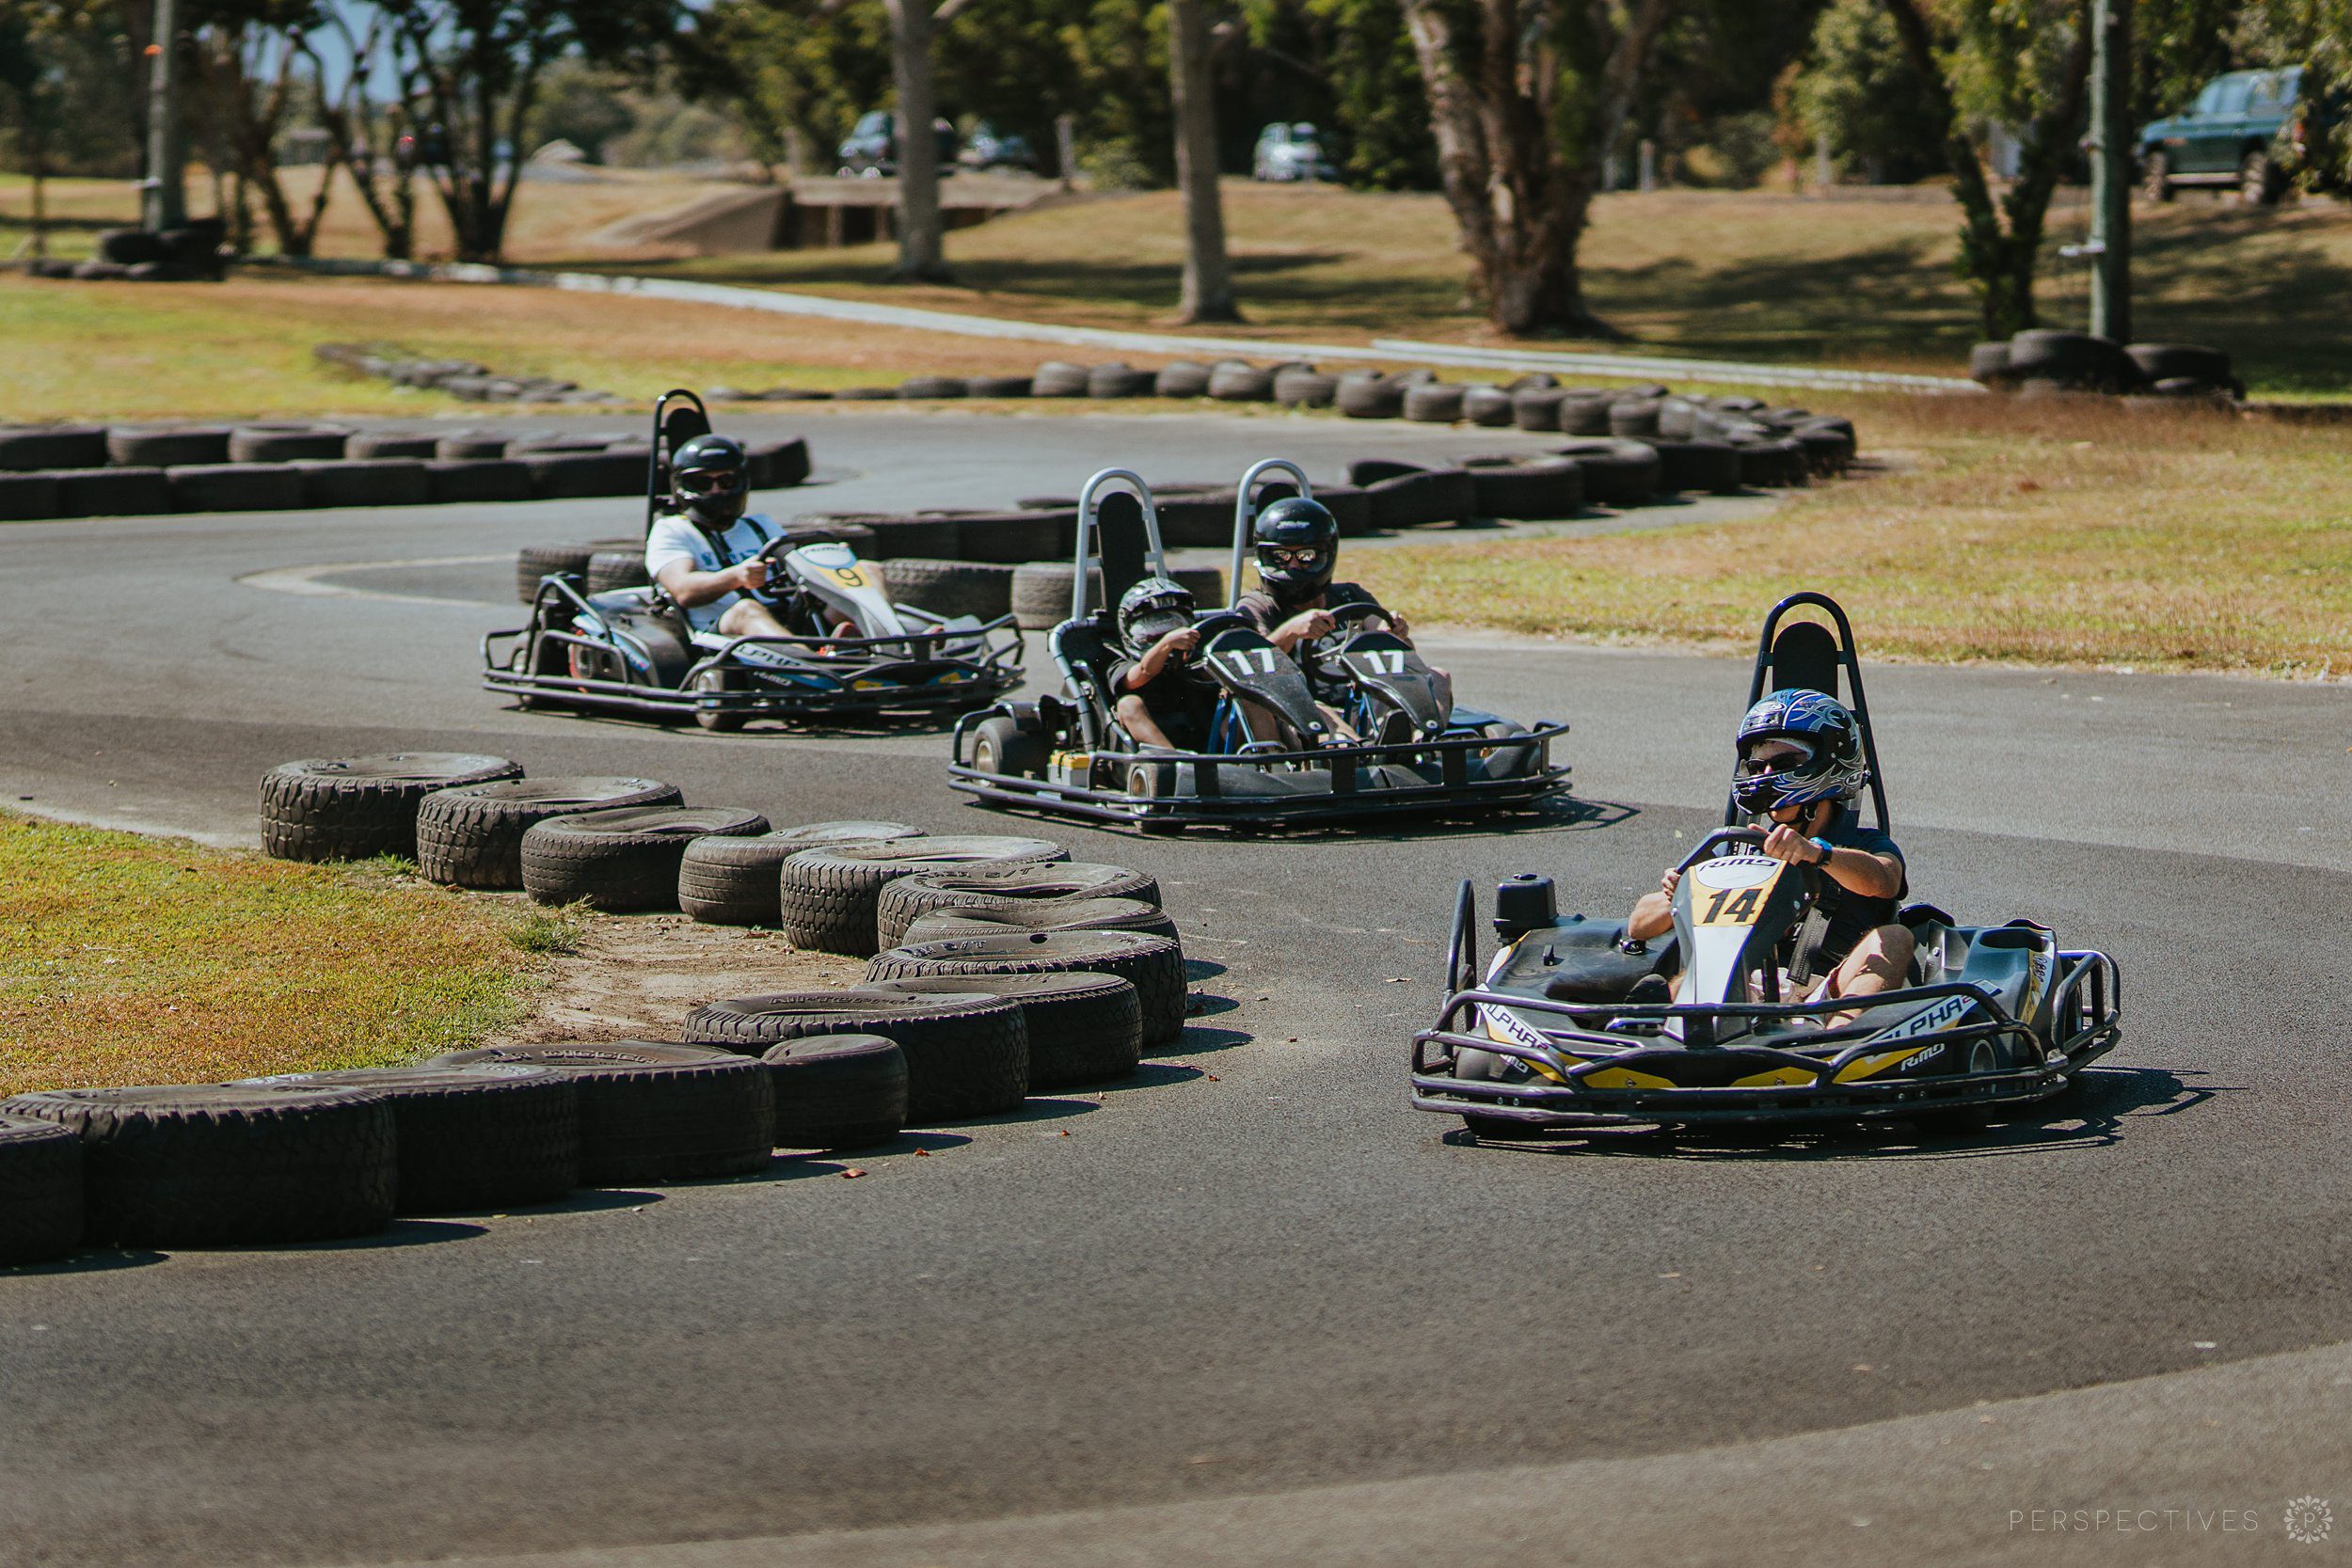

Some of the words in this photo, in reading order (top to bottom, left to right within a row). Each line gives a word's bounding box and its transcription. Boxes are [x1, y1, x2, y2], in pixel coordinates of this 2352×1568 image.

[836, 567, 864, 587] 9
[1227, 647, 1277, 675] 17
[1363, 649, 1405, 674] 17
[1703, 888, 1764, 924] 14
